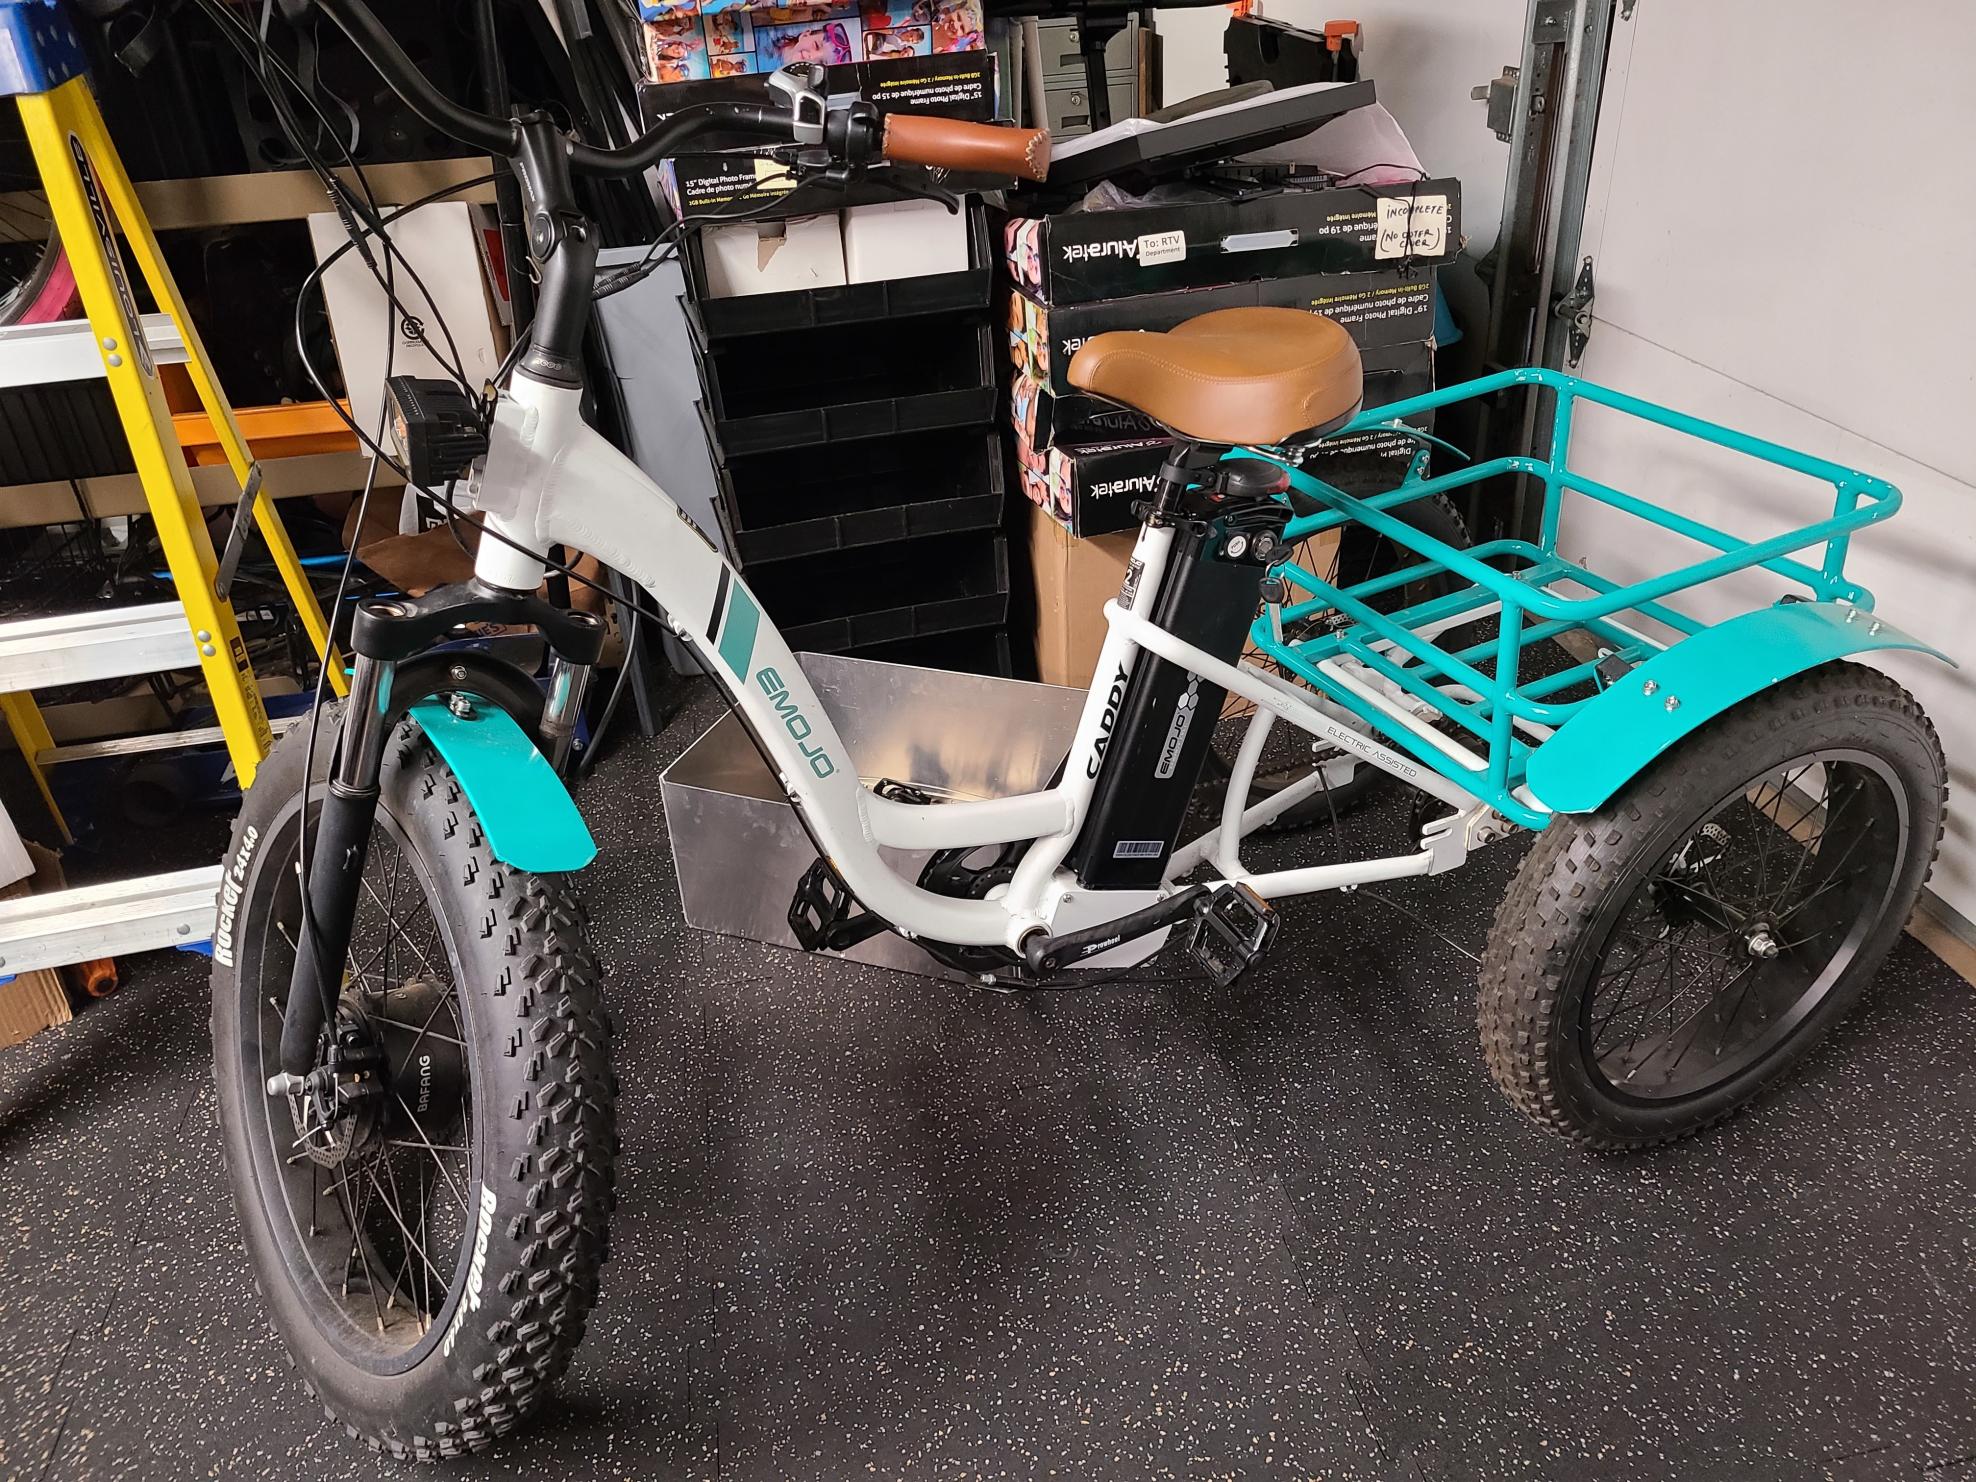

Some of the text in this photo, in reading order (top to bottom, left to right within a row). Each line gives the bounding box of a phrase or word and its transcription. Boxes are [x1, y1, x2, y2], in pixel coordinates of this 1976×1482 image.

[935, 84, 954, 94] photo
[963, 83, 982, 91] Cadre
[872, 92, 881, 100] po
[882, 92, 890, 100] 15
[910, 97, 930, 105] Frame
[931, 94, 949, 103] Photo
[951, 92, 970, 101] Digital
[698, 177, 720, 187] Digital
[719, 175, 739, 184] Photo
[738, 173, 757, 182] Fram
[686, 187, 705, 196] Cadre
[706, 186, 715, 194] de
[715, 184, 734, 194] photo
[1319, 226, 1329, 235] po
[1331, 226, 1341, 234] 19
[1342, 224, 1353, 233] de
[1144, 235, 1180, 249] To: RTV
[1062, 239, 1138, 264] Aluratek
[1145, 247, 1181, 257] Department
[1375, 286, 1397, 296] Memory
[1375, 296, 1397, 307] photo
[1397, 296, 1407, 304] de
[1408, 294, 1429, 303] Cadre
[1324, 307, 1334, 315] de
[1335, 301, 1374, 314] numérique
[1388, 306, 1413, 317] Digital
[1340, 313, 1363, 323] Frame
[1365, 309, 1386, 319] Photo
[1376, 438, 1397, 450] photo
[1388, 447, 1412, 457] Digital
[1091, 475, 1156, 500] Aluratek
[756, 667, 835, 779] EMOJO
[1087, 660, 1128, 780] CADDY
[1160, 714, 1186, 775] EMOJO
[1327, 726, 1417, 778] ELECTRIC ASSISTED
[1081, 933, 1120, 954] Prowheel
[417, 1055, 431, 1113] BAFANG
